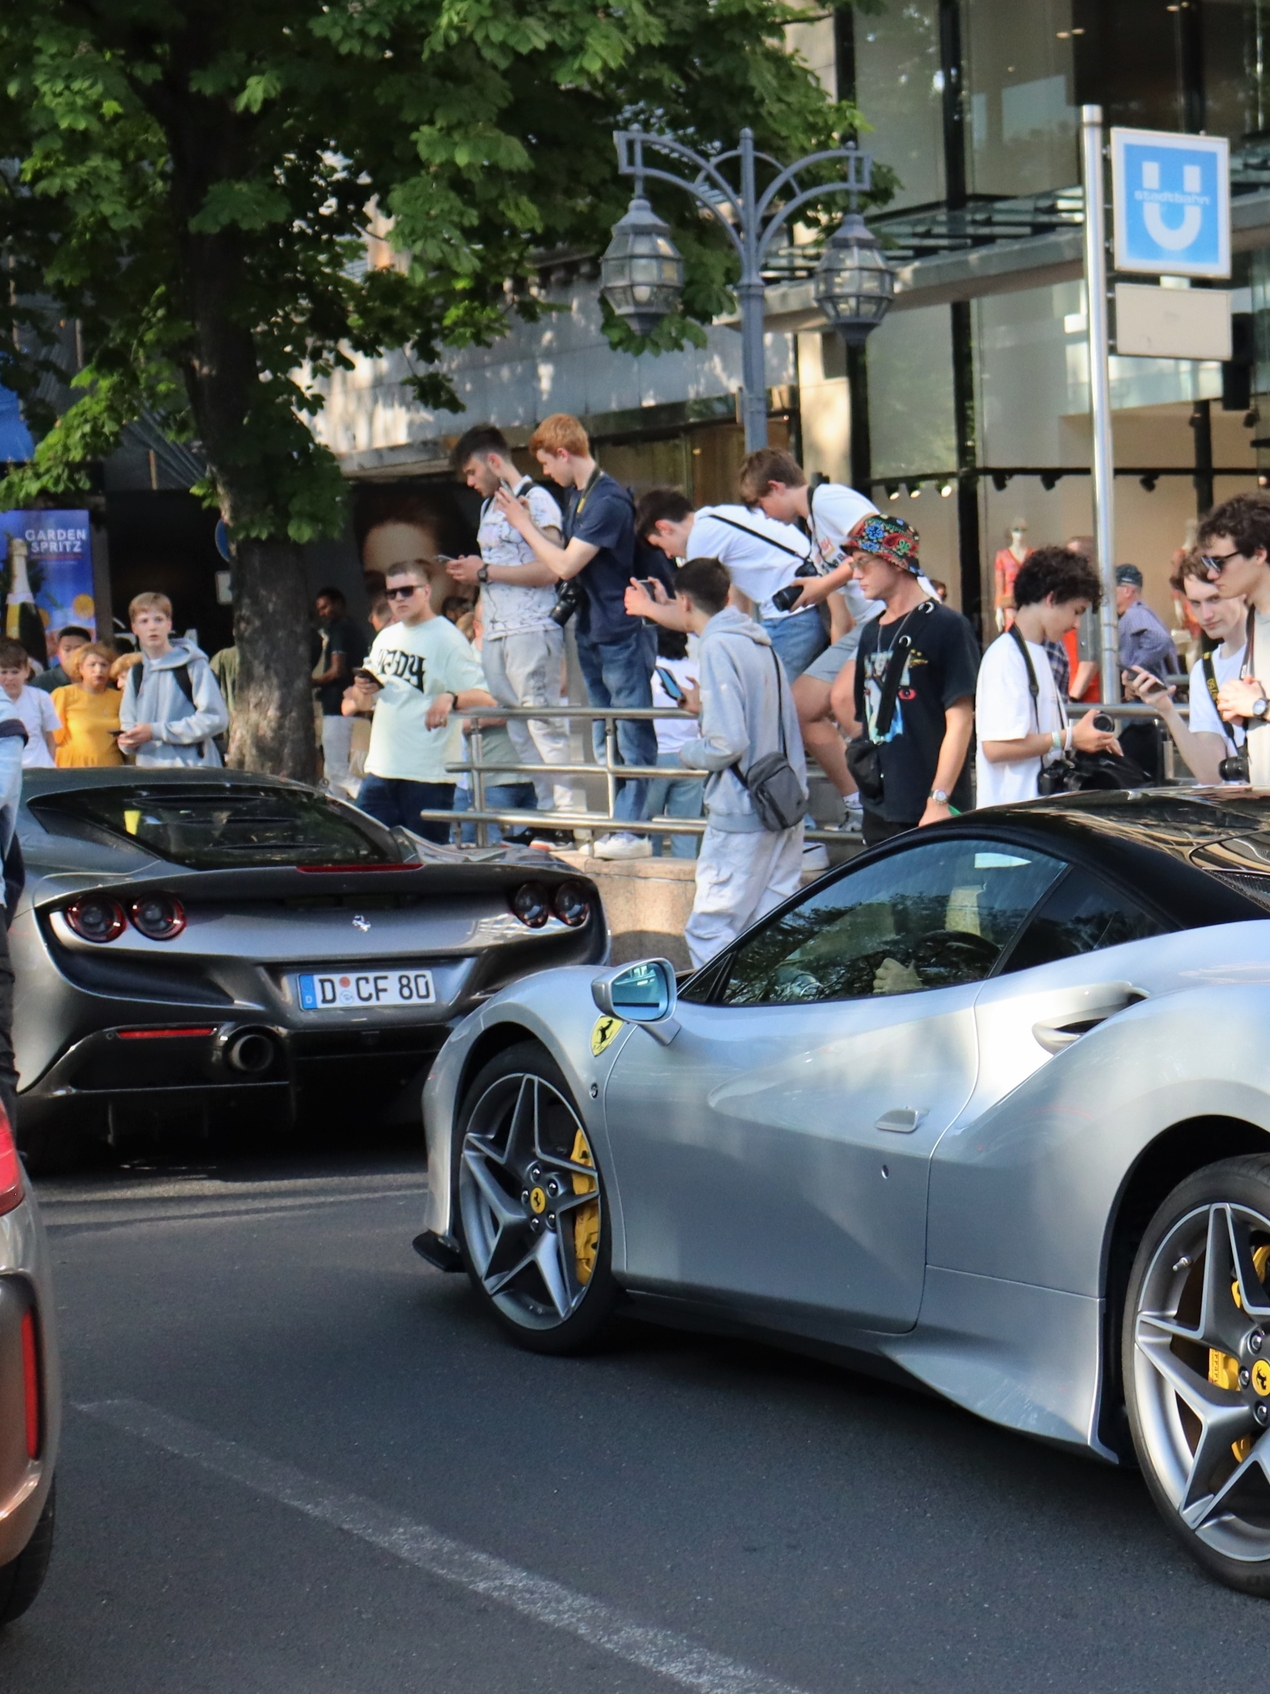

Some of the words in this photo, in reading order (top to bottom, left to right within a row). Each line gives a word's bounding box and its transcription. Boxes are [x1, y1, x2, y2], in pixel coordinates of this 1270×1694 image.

[25, 529, 87, 541] GARDEN
[31, 541, 82, 553] SPRITZ
[318, 978, 337, 1004] D
[355, 975, 389, 1002] CF
[398, 974, 430, 1000] 80
